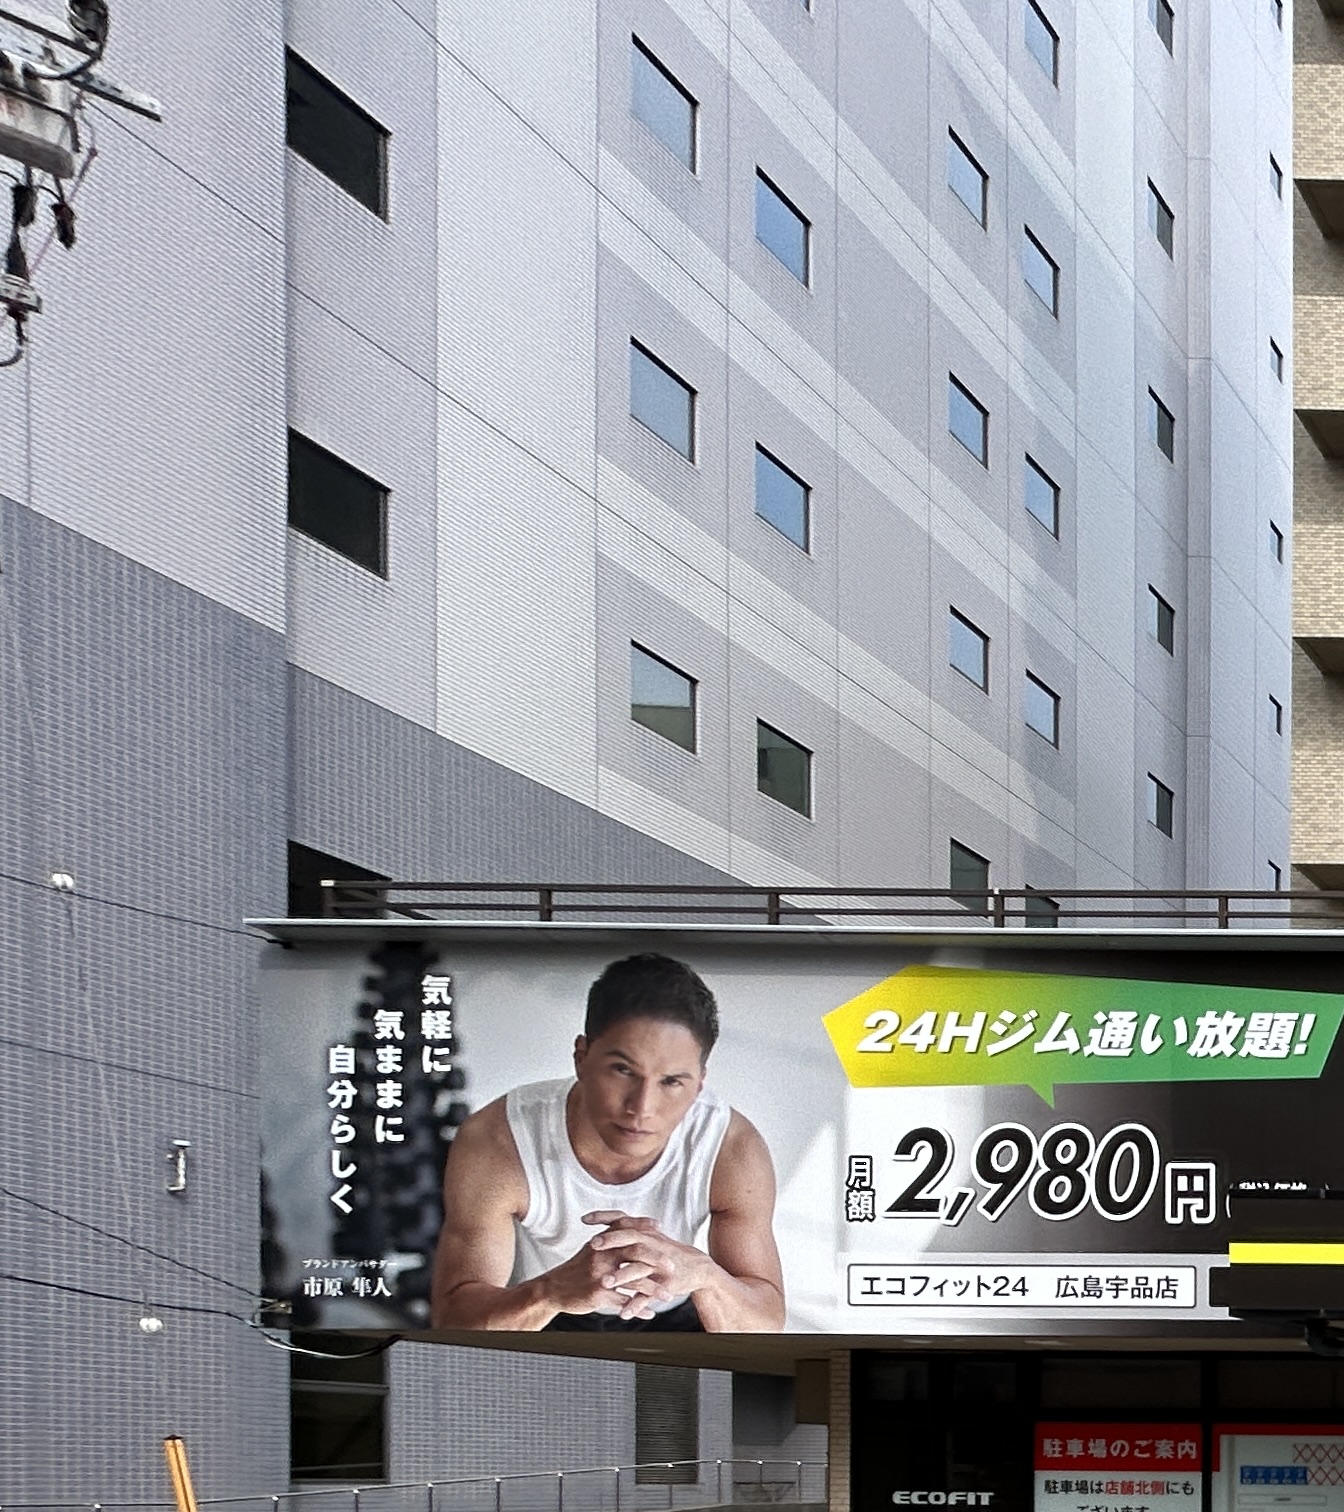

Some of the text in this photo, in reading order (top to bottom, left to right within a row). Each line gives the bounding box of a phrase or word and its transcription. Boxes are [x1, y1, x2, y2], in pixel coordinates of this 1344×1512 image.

[420, 974, 453, 1075] 気軽に
[856, 1008, 1317, 1060] 24Hジム通い放題!
[373, 1009, 405, 1144] 気ままに
[326, 1045, 358, 1215] 自分らしく
[846, 1156, 876, 1222] 月額
[303, 1276, 344, 1297] 市原
[861, 1275, 1179, 1299] エコフィット24 広島宇品店
[1043, 1438, 1198, 1459] 駐車場のご案内
[892, 1491, 994, 1506] ECOFIT
